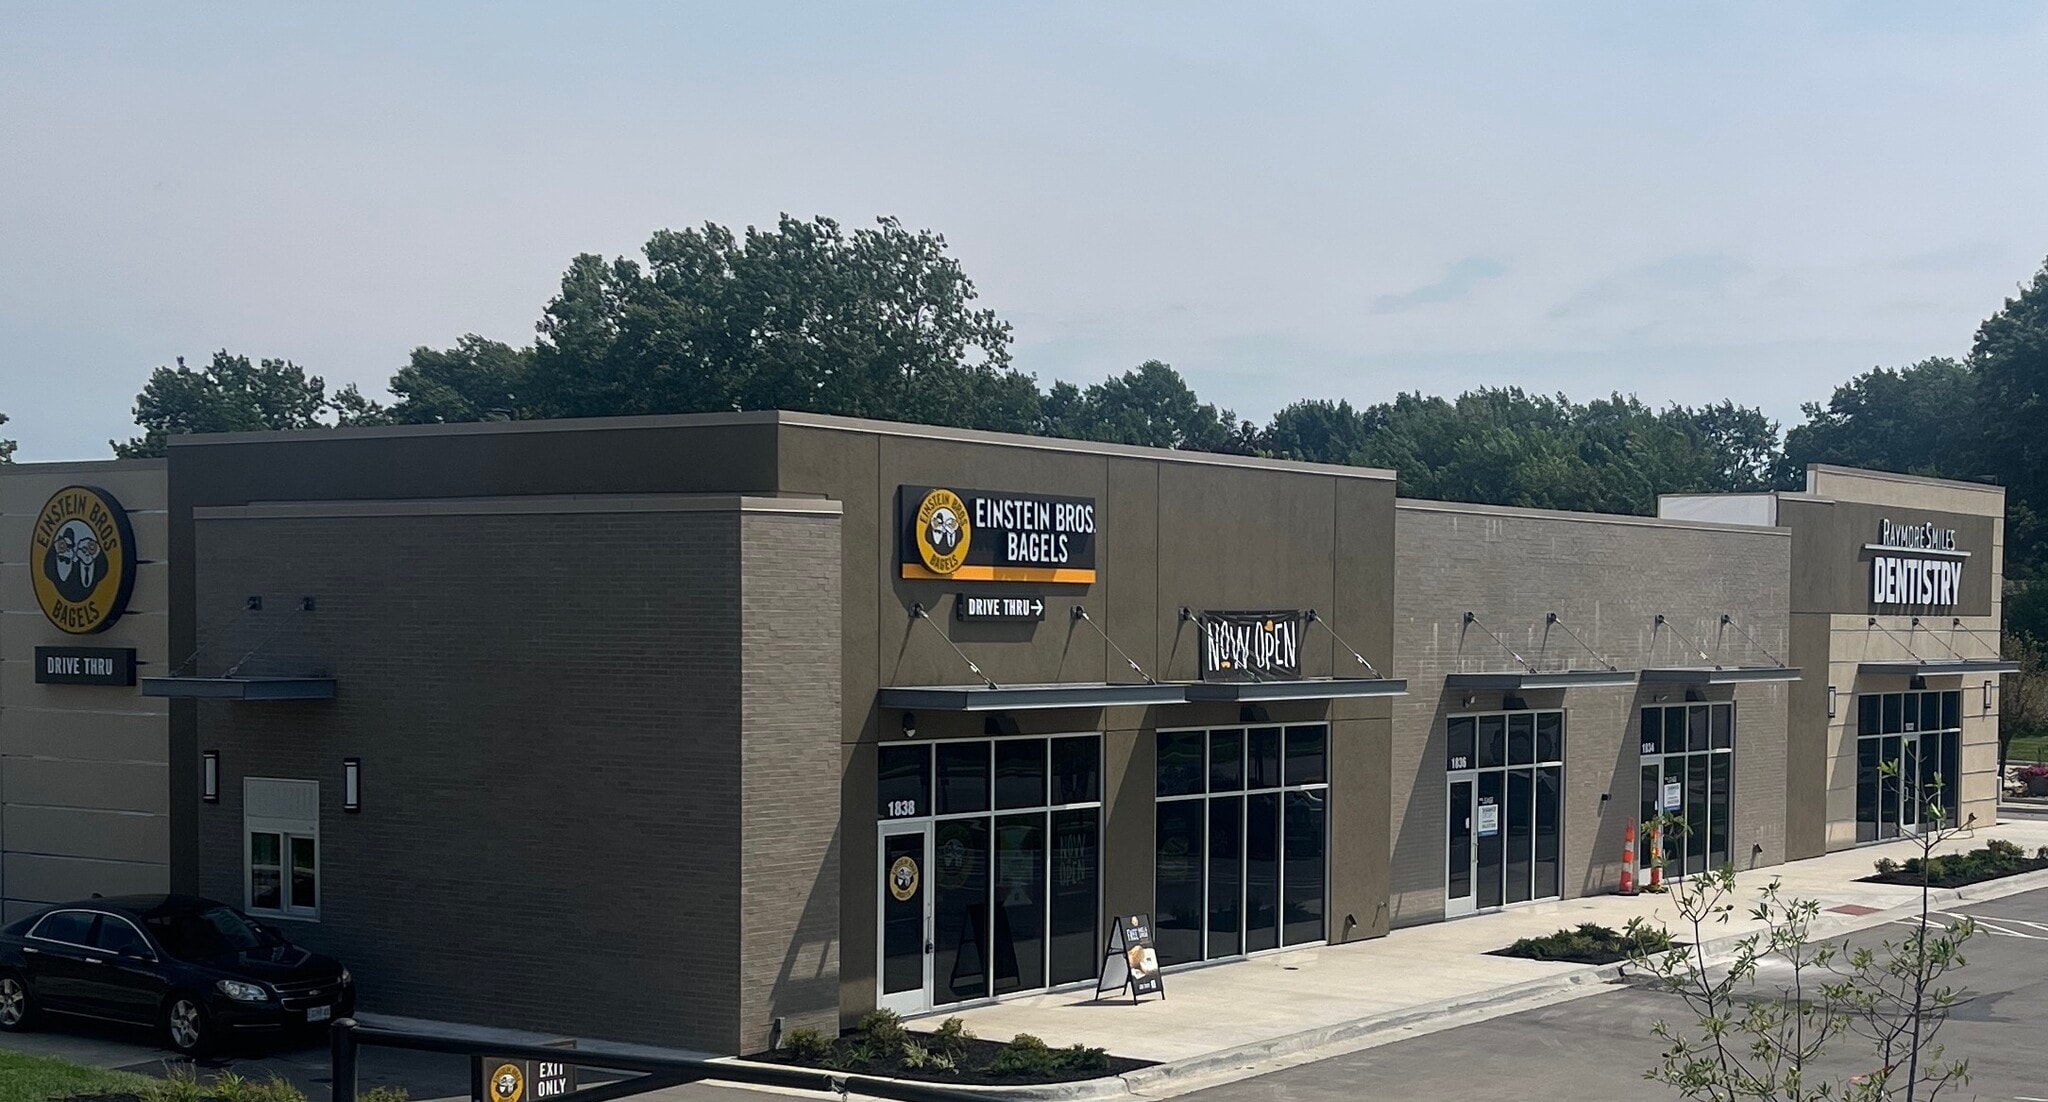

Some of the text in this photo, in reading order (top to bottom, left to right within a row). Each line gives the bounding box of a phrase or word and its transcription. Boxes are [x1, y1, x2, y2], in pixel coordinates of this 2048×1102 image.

[36, 494, 118, 552] EINSTEIN BROS
[920, 493, 968, 527] EINSTEIN BROS
[975, 497, 1051, 532] EINSTEIN
[929, 553, 959, 571] BAGELS
[1007, 532, 1068, 563] BAGELS
[1873, 556, 1962, 606] DENTISTRY
[51, 598, 101, 629] BAGELS
[968, 597, 1030, 617] DRIVE THRU
[1207, 619, 1296, 671] NOW OPEN
[47, 656, 113, 676] DRIVE THRU
[1451, 756, 1467, 770] 1836
[887, 800, 915, 817] 1838
[538, 1078, 567, 1097] ONLY
